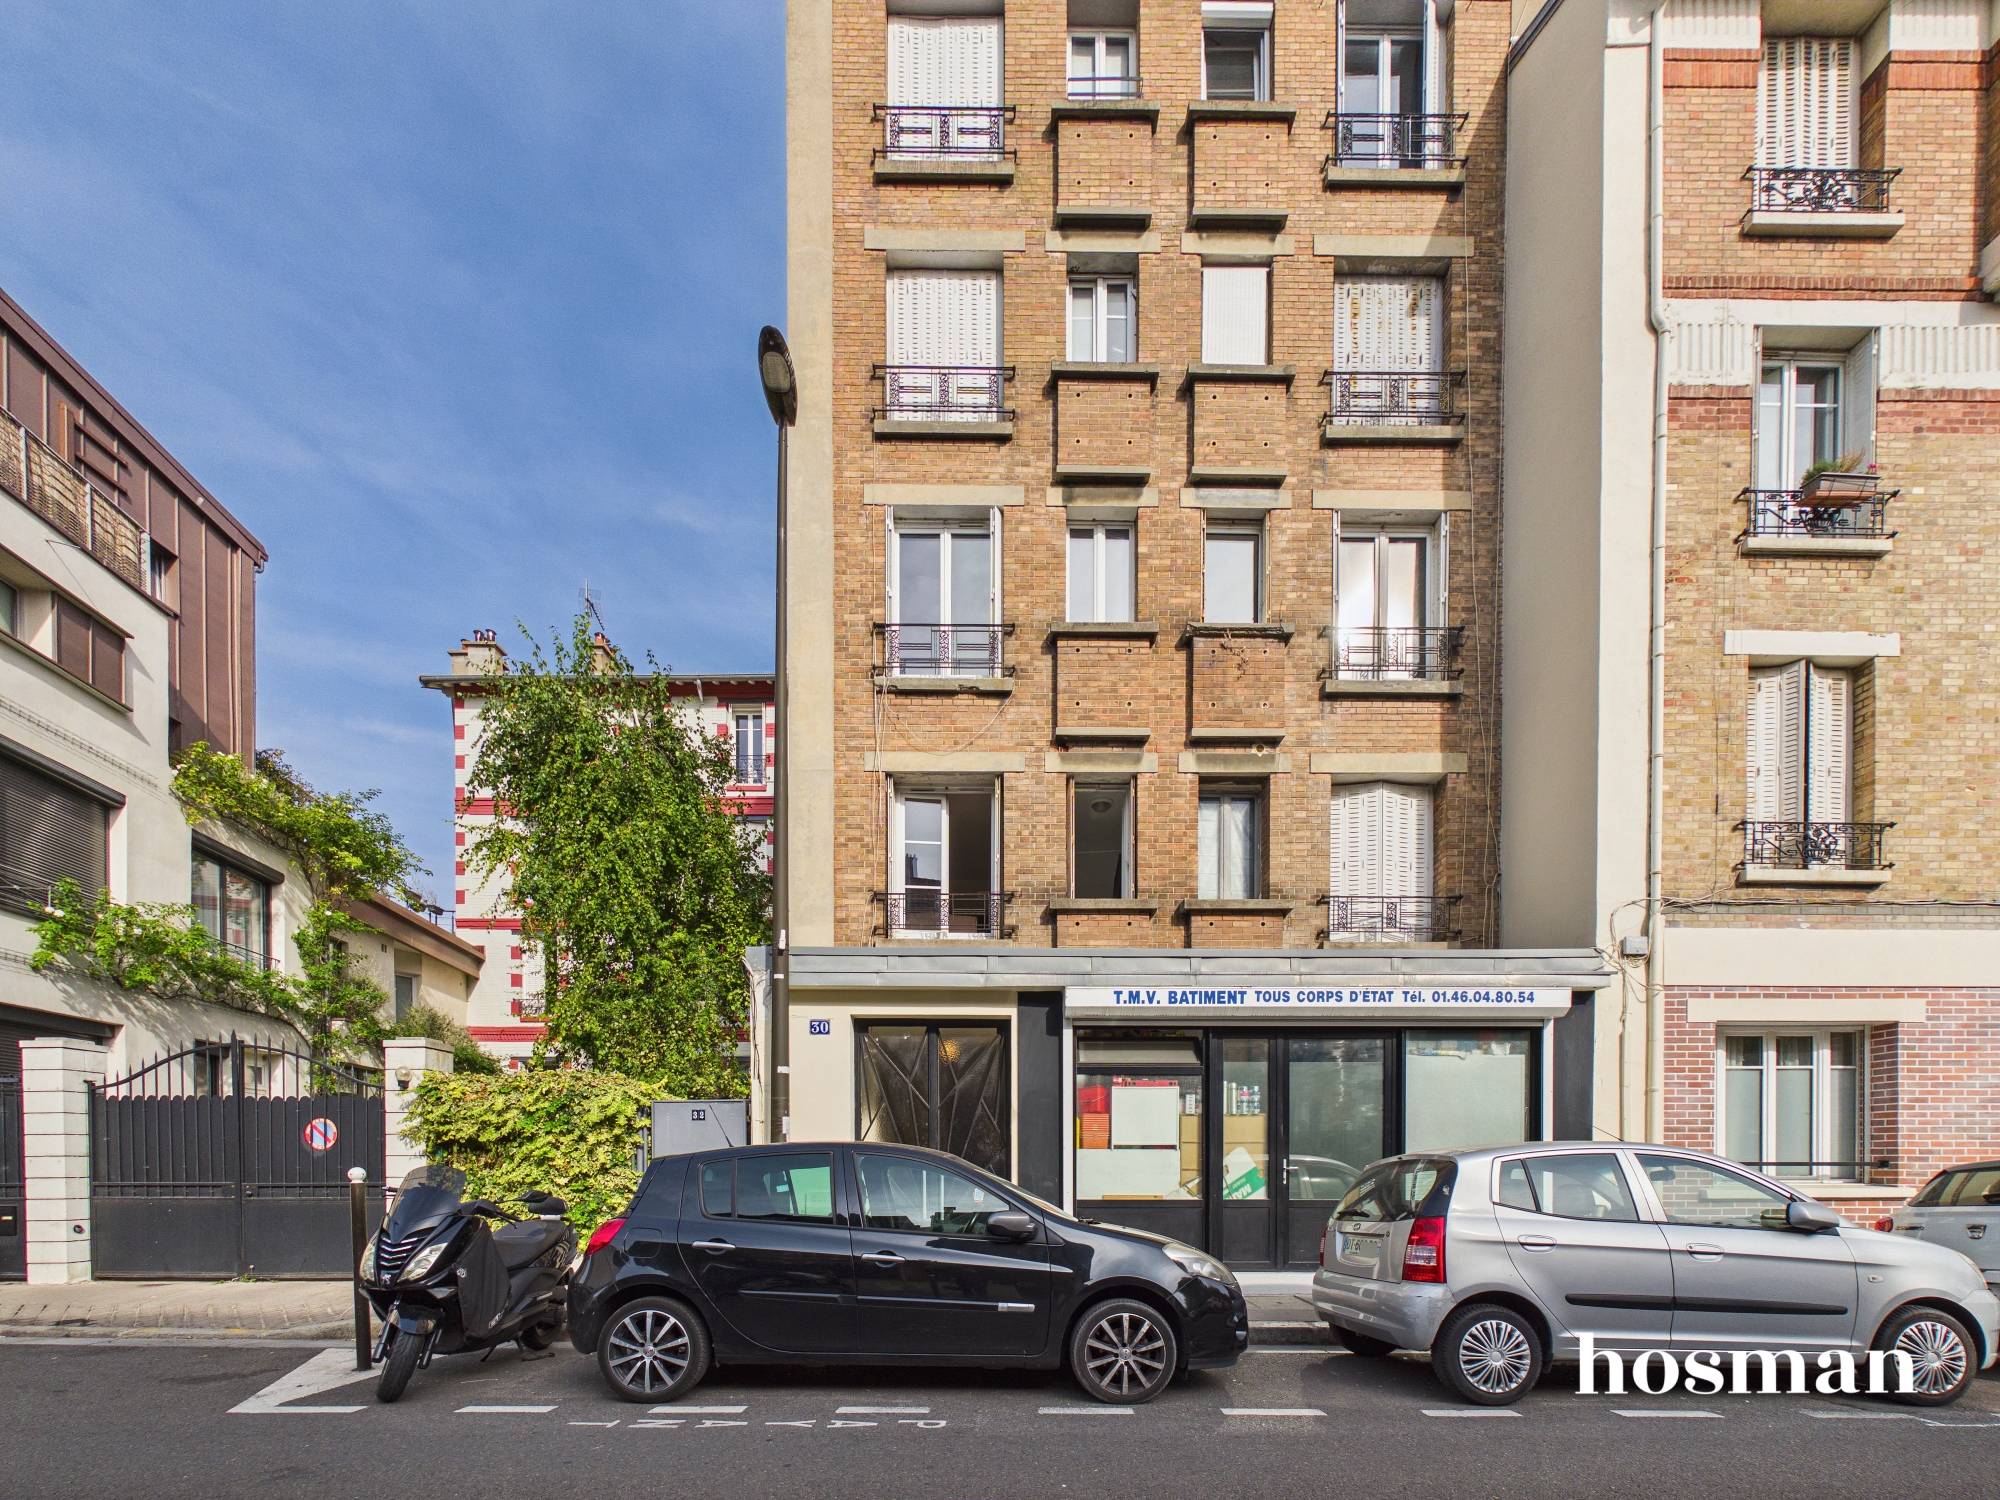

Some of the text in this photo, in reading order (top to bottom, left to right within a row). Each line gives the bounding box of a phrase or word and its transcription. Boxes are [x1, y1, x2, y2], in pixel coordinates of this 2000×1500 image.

[1113, 988, 1535, 1005] T.M.V. BATIMENT TOUS CORPS D'ÉTAT Tél. 01.46.04.80.54
[811, 1021, 829, 1034] 30
[692, 1110, 705, 1120] 32
[567, 1419, 947, 1429] PAYANT
